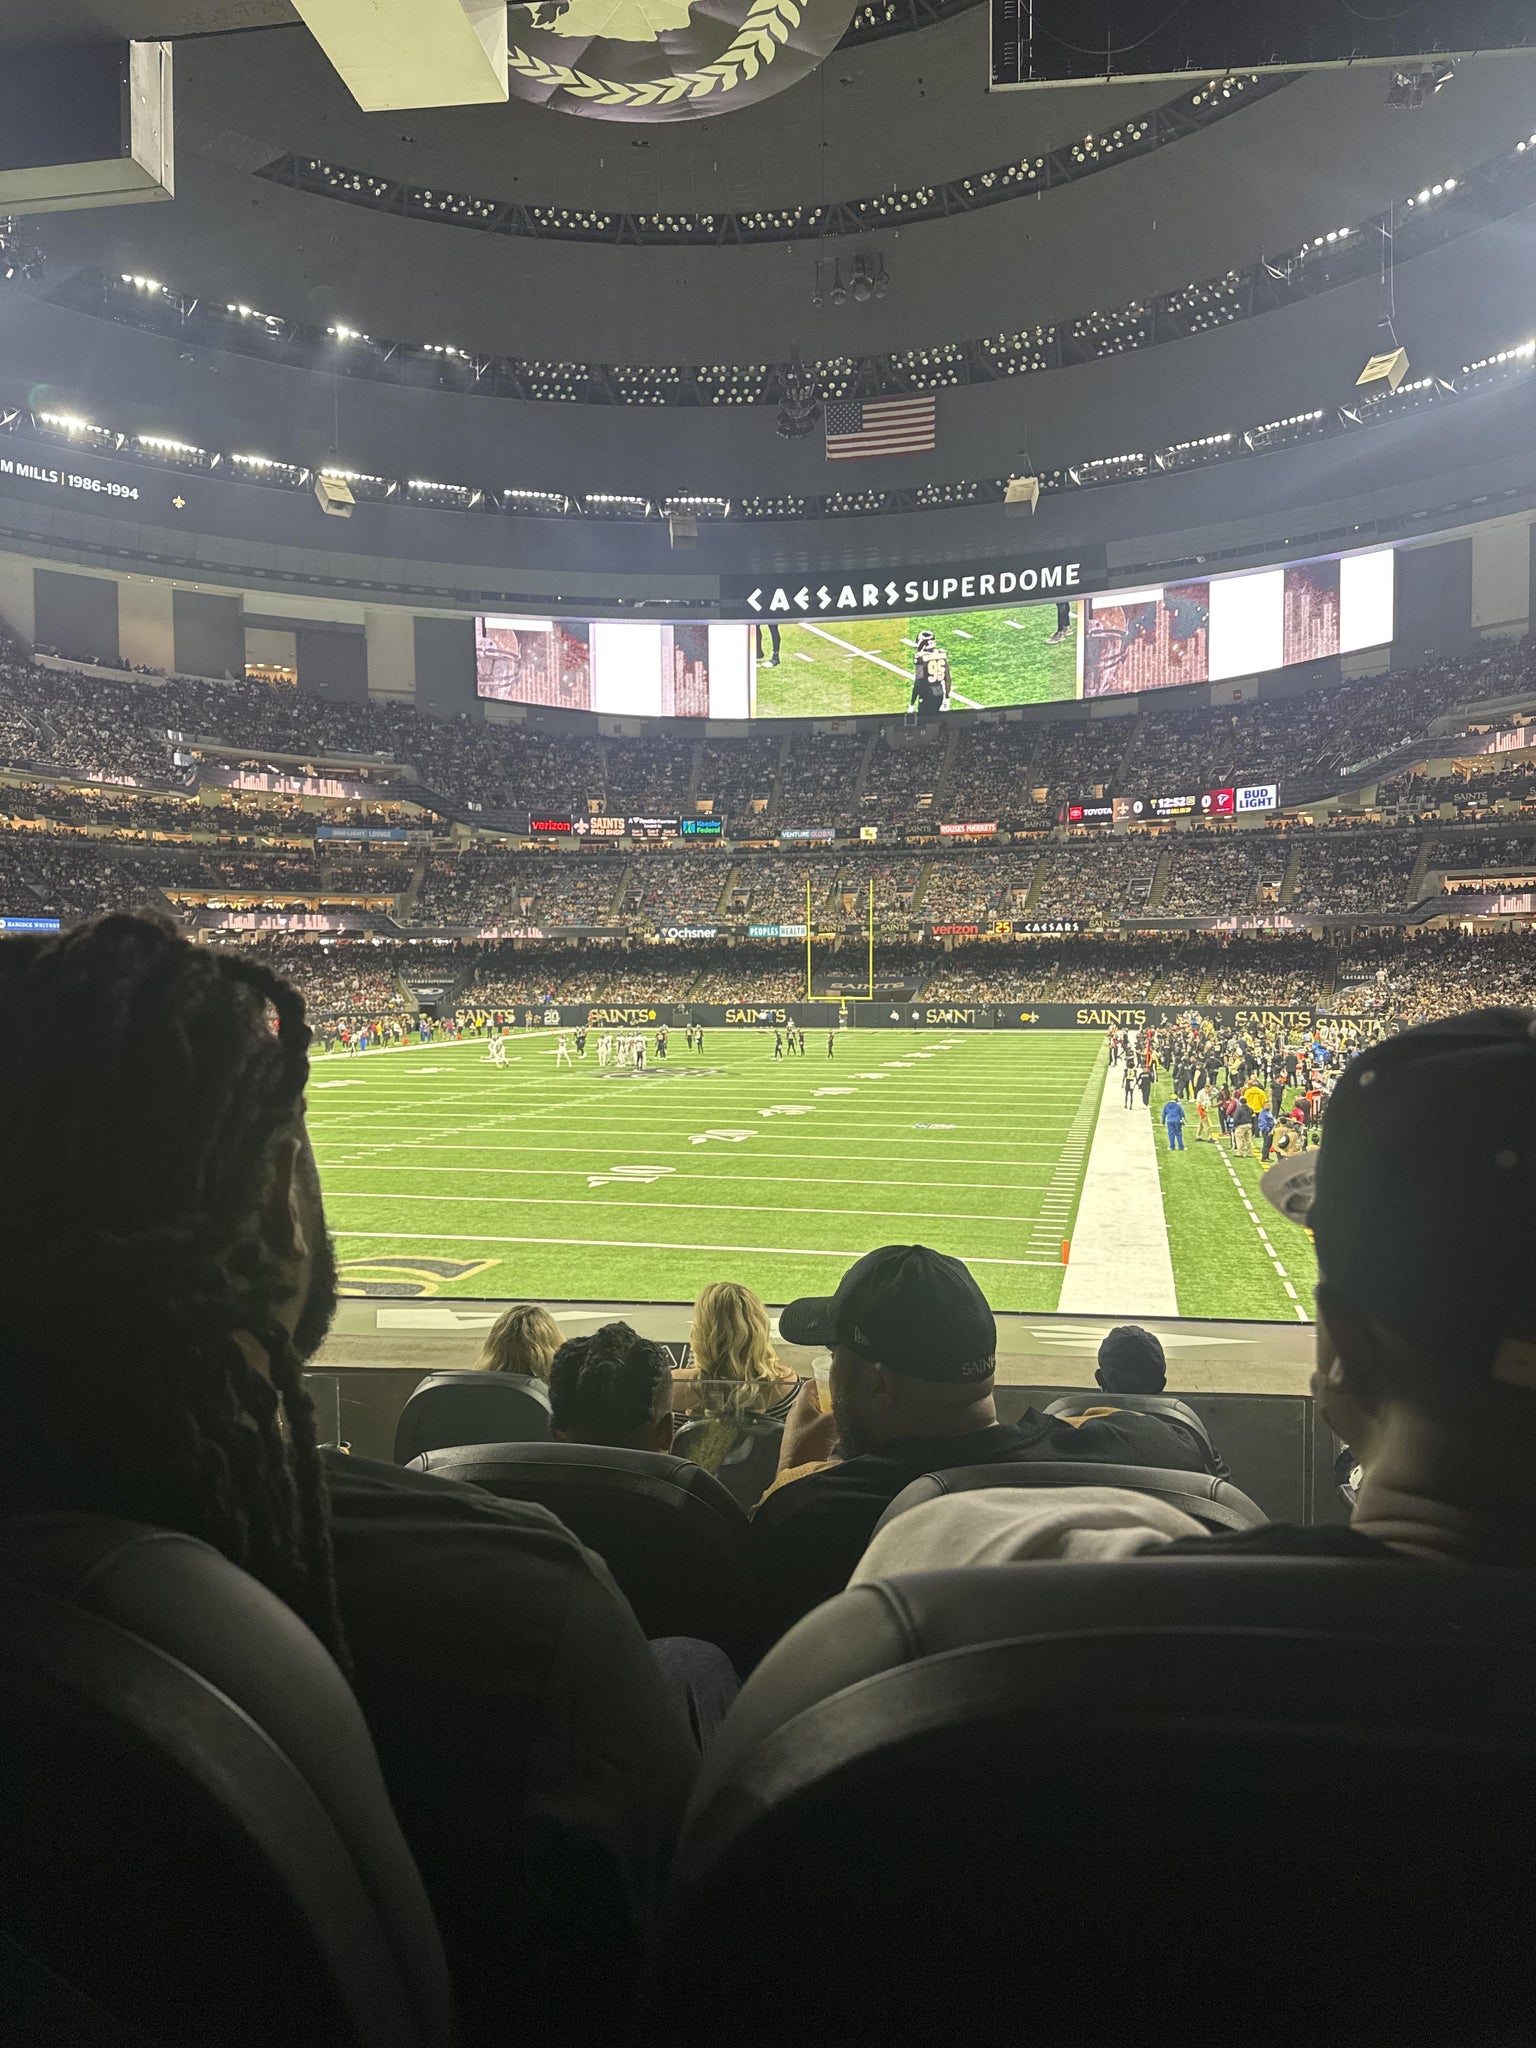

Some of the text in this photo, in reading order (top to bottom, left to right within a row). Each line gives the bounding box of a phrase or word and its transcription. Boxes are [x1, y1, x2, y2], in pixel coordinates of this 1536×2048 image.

[16, 463, 58, 483] MILLS
[68, 475, 139, 500] 1986-1994
[746, 563, 1081, 612] CAESARS SUPERDOME
[1244, 789, 1269, 798] BUD
[1454, 792, 1488, 801] SAINTS
[1239, 797, 1274, 809] LIGHT
[1083, 808, 1113, 816] TOYOTA
[532, 820, 570, 831] verizon
[590, 817, 625, 829] SAINTS
[696, 819, 721, 827] Keesler
[941, 824, 997, 833] ROUSES MARKETS
[696, 826, 721, 834] Federal
[880, 923, 909, 931] SAINTS
[932, 923, 978, 935] verizon
[995, 921, 1010, 933] 25
[1024, 922, 1080, 933] CAESARS
[1089, 920, 1120, 928] SAINTS
[668, 927, 716, 938] Ochsner
[750, 926, 806, 936] PEOPLES HEALTH
[544, 1011, 560, 1023] 20
[587, 1009, 648, 1022] SAINTS
[926, 1009, 975, 1023] SAINT
[1077, 1009, 1146, 1024] SAINTS
[1234, 1011, 1311, 1027] SAINTS
[1316, 1019, 1376, 1036] SAINT
[687, 1129, 760, 1145] 20
[586, 1165, 677, 1188] 10
